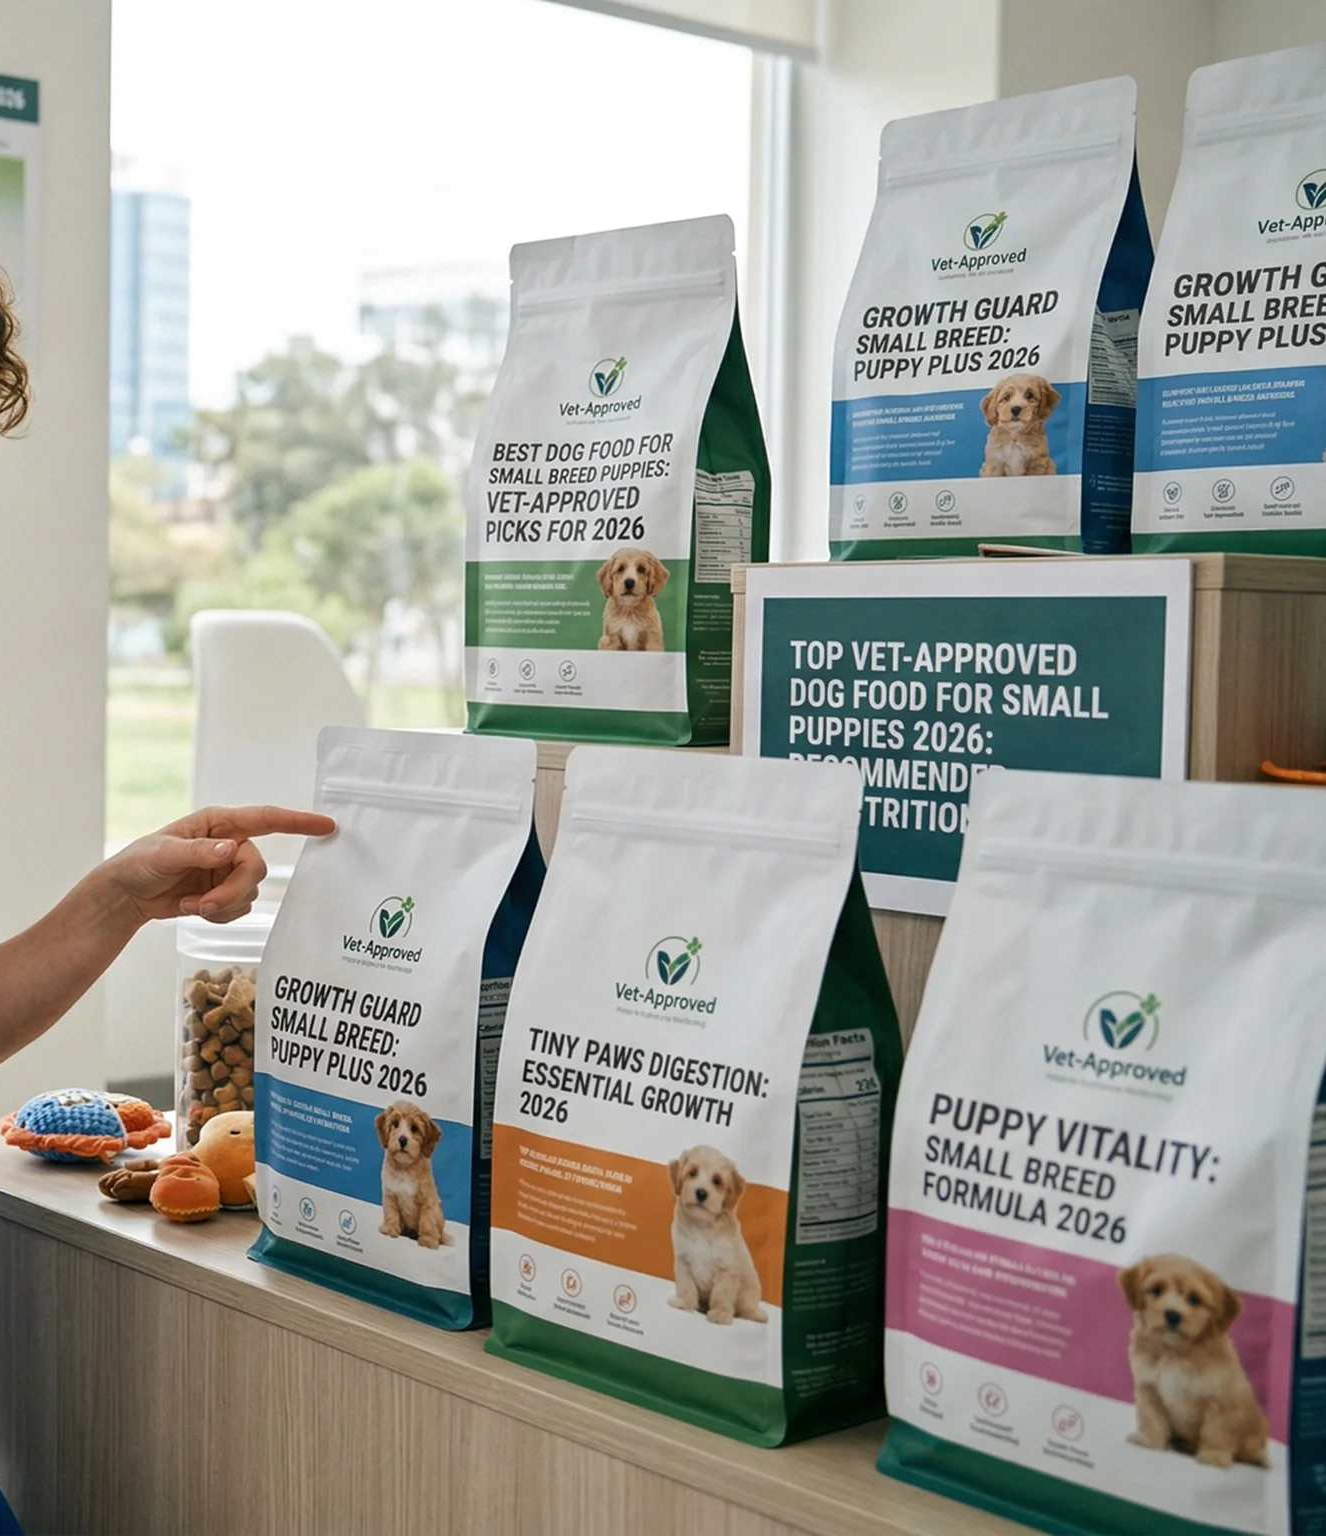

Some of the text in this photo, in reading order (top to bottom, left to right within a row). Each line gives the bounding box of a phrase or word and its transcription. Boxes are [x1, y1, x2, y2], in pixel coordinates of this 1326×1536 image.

[1258, 215, 1326, 235] Vet-App
[931, 248, 1027, 272] Vet-Approved
[1174, 264, 1302, 298] GROWTH
[863, 290, 1059, 329] GROWTH GUARD
[1167, 300, 1255, 327] SMALL
[856, 325, 1011, 355] SMALL BREED:
[1165, 322, 1326, 357] PUPPY PLUS
[854, 345, 1040, 381] PUPPY PLUS 2026
[559, 395, 642, 417] Vet-Approved
[492, 433, 673, 462] BEST DOG FOOD FOR
[488, 459, 670, 485] SMALL BREED PUPPIES:
[487, 486, 640, 514] VET-APPROVED
[486, 516, 645, 543] PICKS FOR 2026
[790, 640, 1077, 676] TOP VET-APPROVED
[790, 678, 1109, 719] DOG FOOD FOR SMALL
[789, 715, 993, 755] PUPPIES 2026:
[343, 935, 422, 963] Vet-Approved
[274, 975, 422, 1028] GROWTH GUARD
[615, 982, 717, 1014] Vet-Approved
[270, 1006, 400, 1057] SMALL BREED:
[271, 1036, 427, 1097] PUPPY PLUS 2026
[530, 1027, 580, 1059] TINY
[584, 1039, 645, 1074] PAWS
[648, 1051, 769, 1098] DIGESTION:
[1043, 1044, 1187, 1086] Vet-Approved
[520, 1090, 569, 1123] 2026
[522, 1059, 734, 1127] ESSENTIAL GROWTH
[929, 1093, 1220, 1183] PUPPY VITALITY:
[925, 1135, 1116, 1201] SMALL BREED
[923, 1171, 1127, 1244] FORMULA 2026
